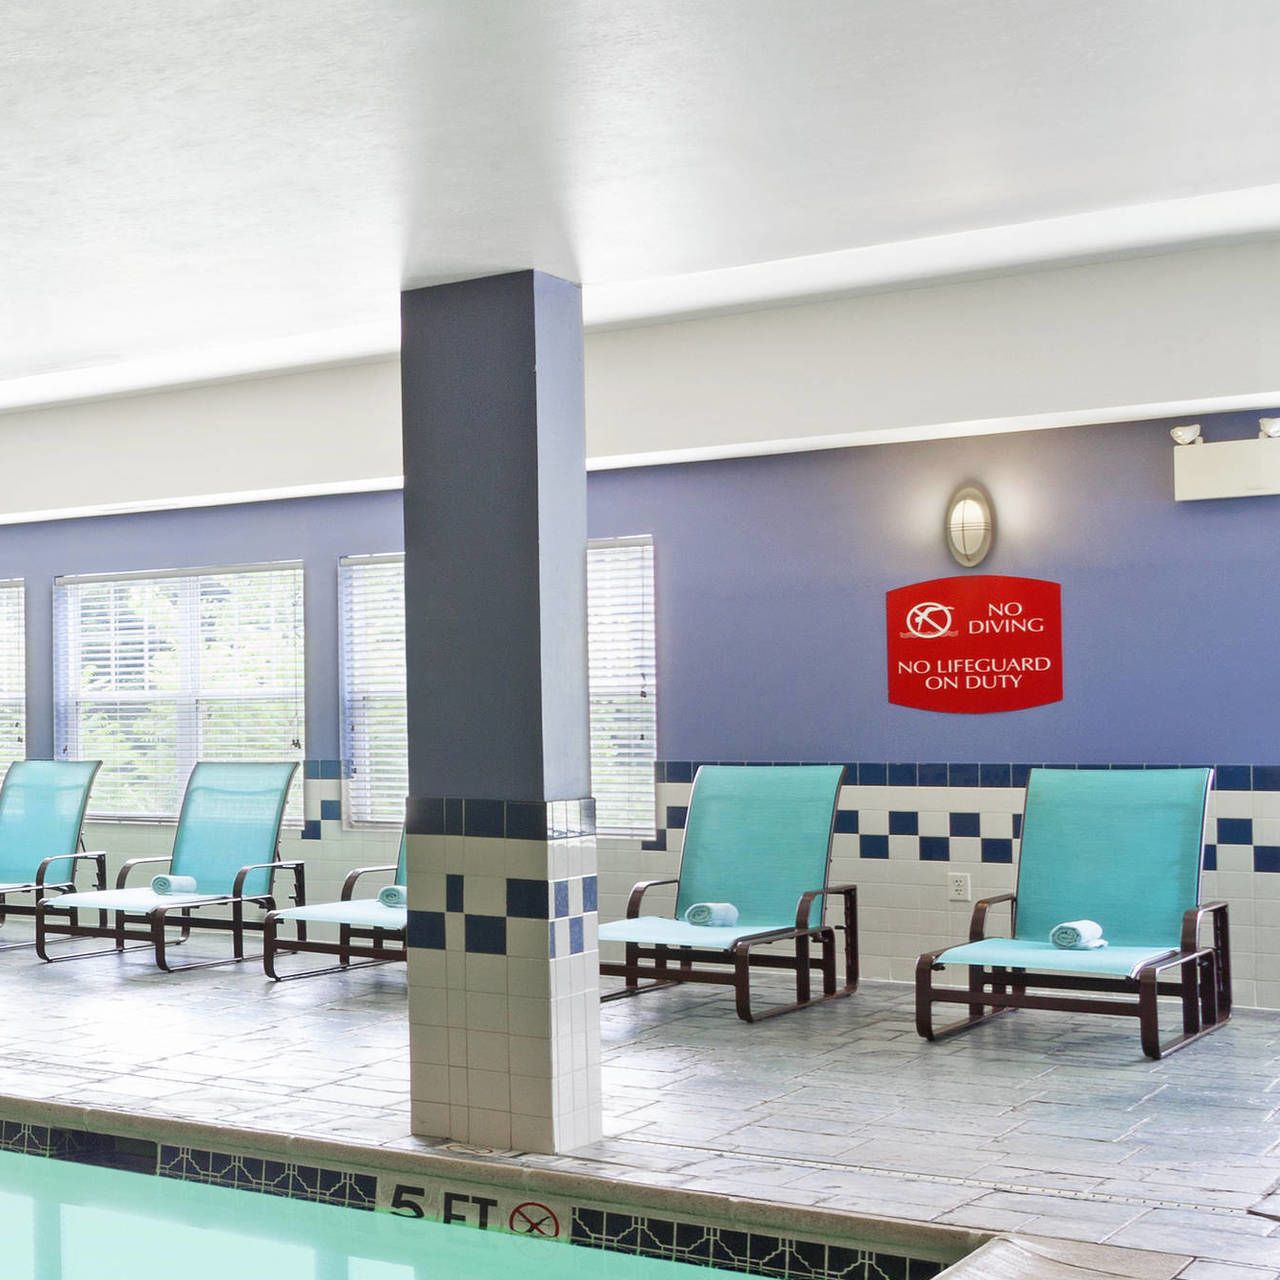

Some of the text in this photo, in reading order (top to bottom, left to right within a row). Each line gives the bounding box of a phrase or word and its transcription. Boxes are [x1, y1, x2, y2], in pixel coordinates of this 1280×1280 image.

[988, 602, 1022, 617] NO
[968, 618, 1044, 634] DIVING
[898, 657, 1051, 674] NO LIFEGUARD
[925, 674, 1022, 690] ON DUTY
[391, 1184, 498, 1230] 5 FT
